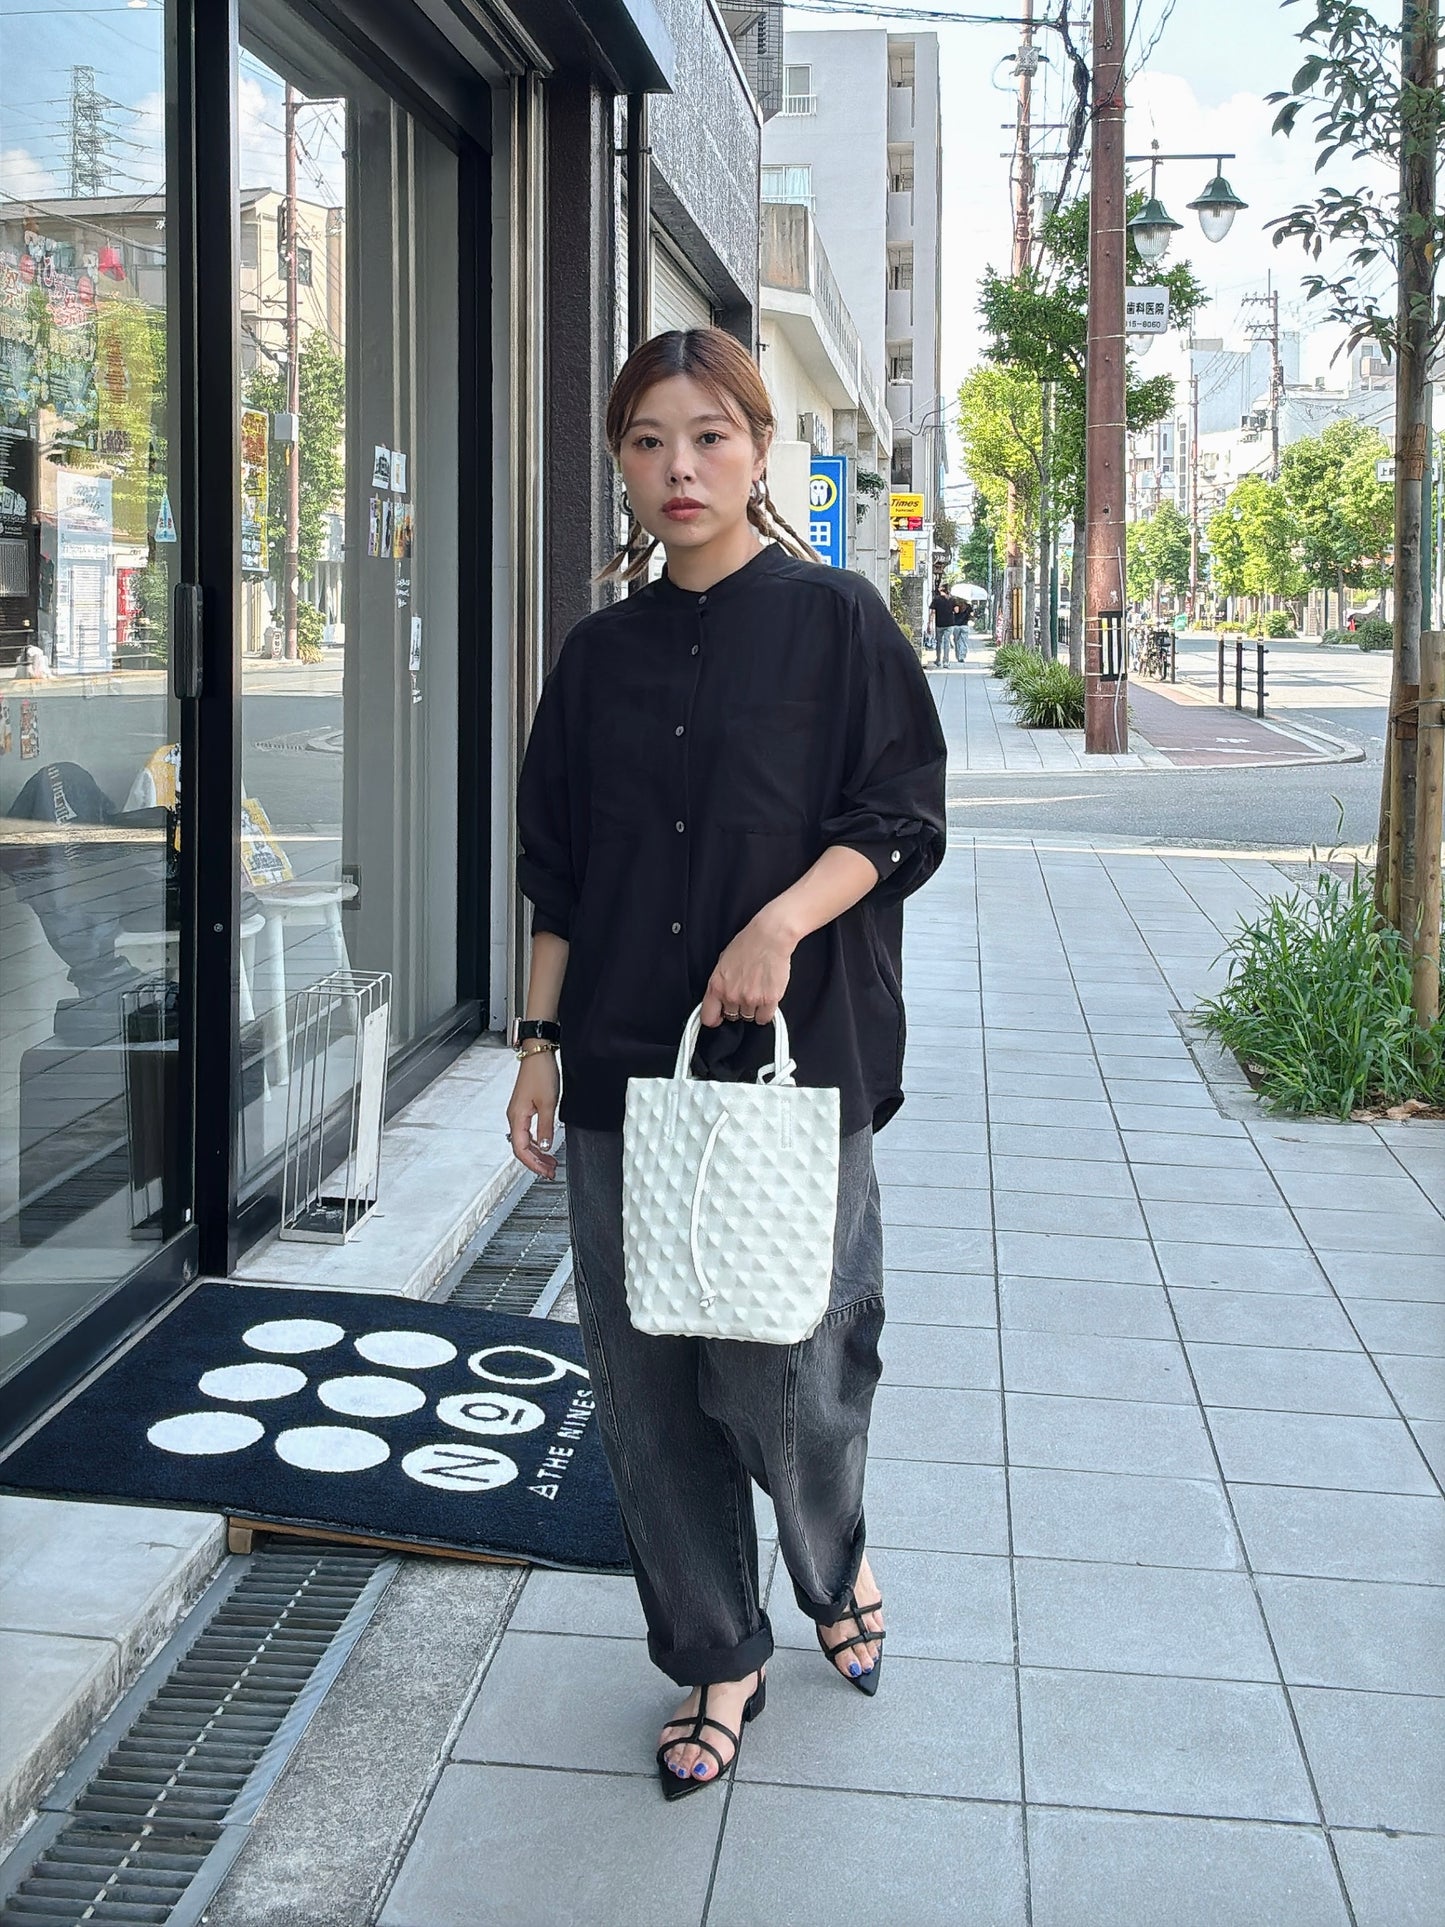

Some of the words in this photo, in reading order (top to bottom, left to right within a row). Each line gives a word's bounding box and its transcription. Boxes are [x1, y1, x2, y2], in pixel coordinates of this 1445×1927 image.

[1127, 302, 1164, 315] 歯科医院
[891, 498, 920, 508] Times
[556, 1389, 596, 1441] NINES
